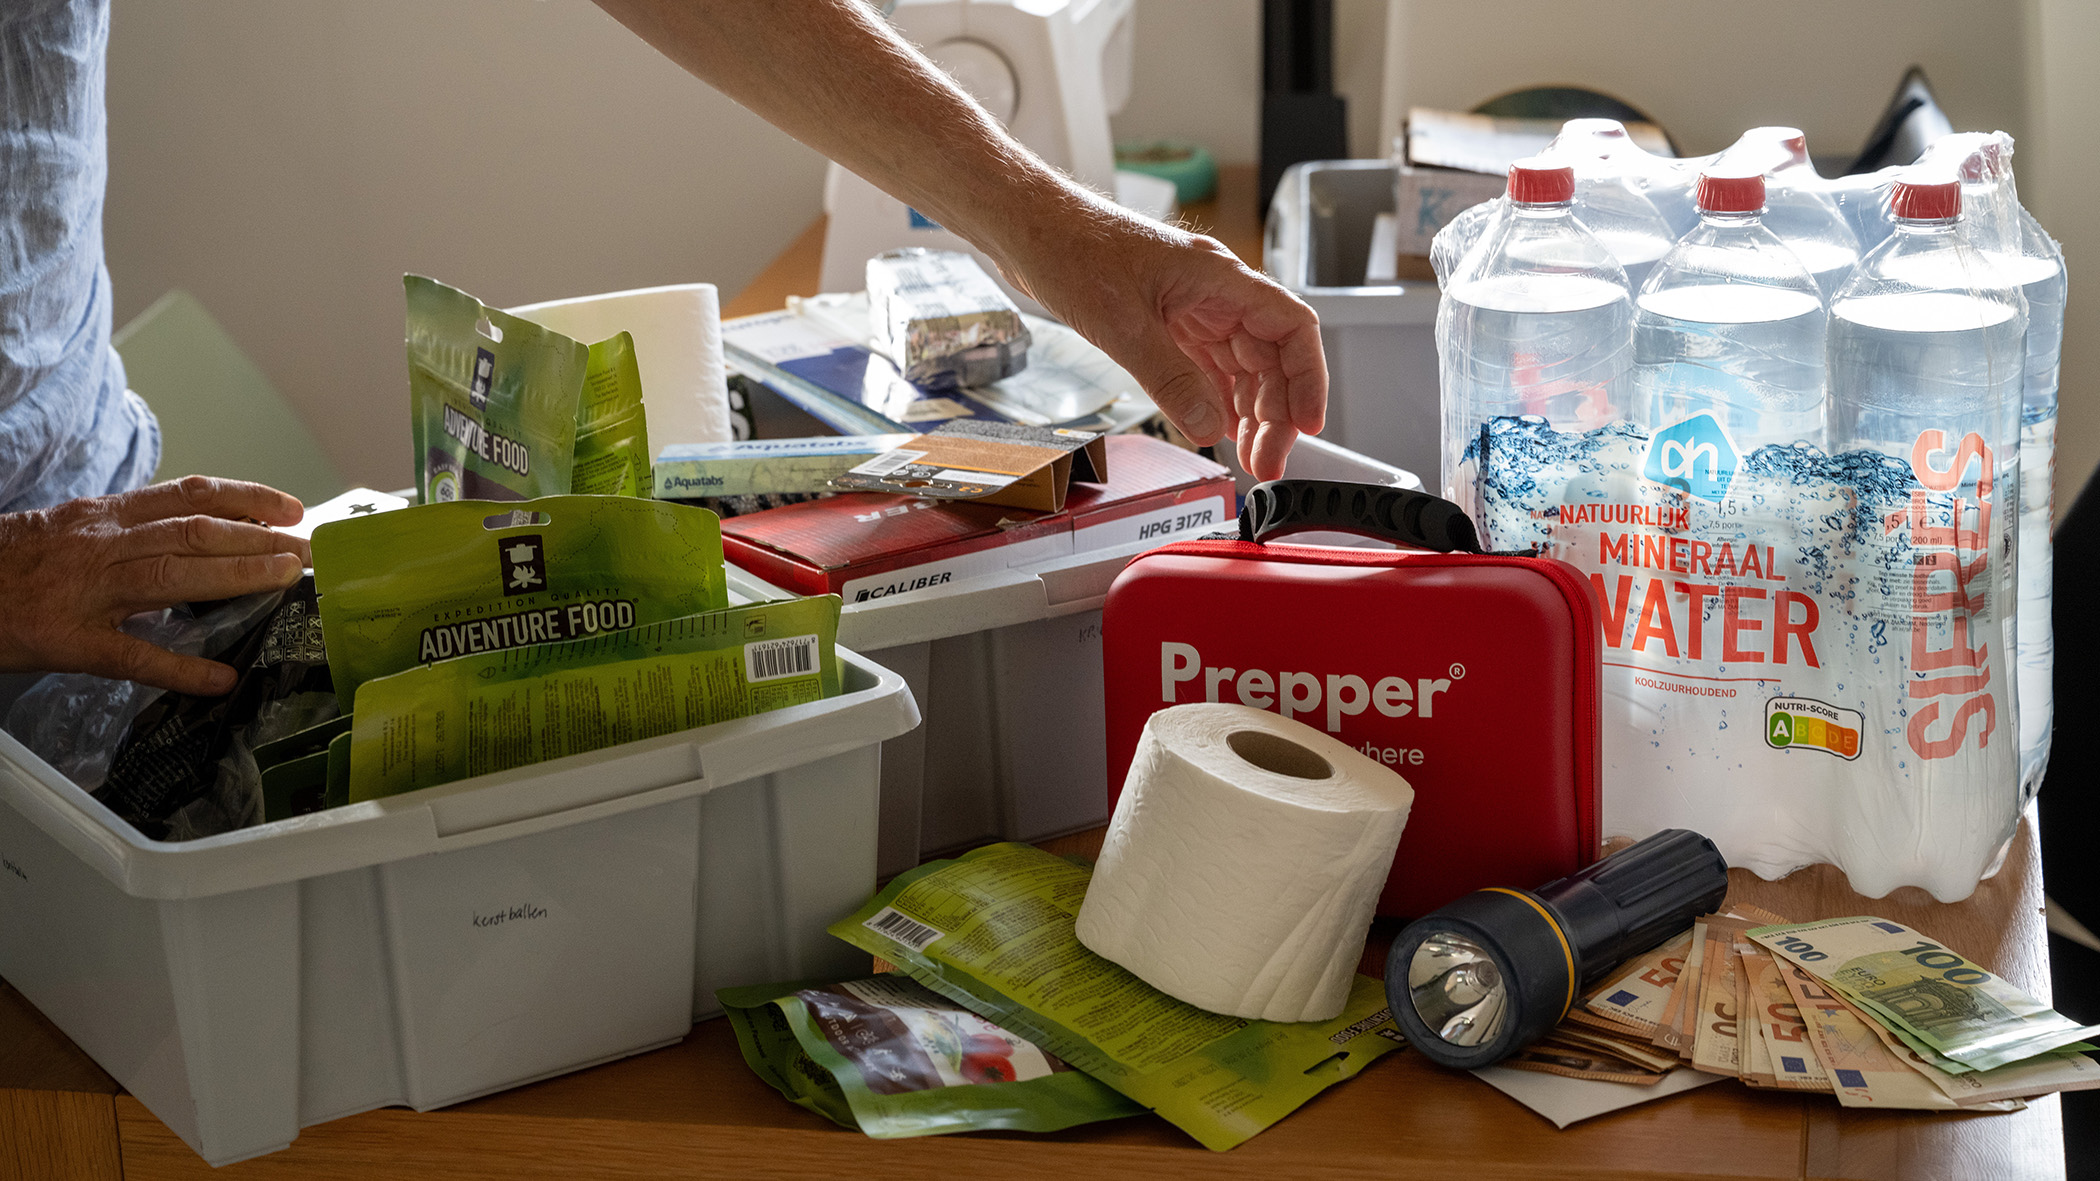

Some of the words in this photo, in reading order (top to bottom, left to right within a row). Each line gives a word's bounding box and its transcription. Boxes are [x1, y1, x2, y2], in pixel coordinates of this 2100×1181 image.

[443, 405, 490, 461] ADVENTURE
[493, 435, 530, 476] FOOD
[735, 440, 868, 451] Aquatabs
[674, 474, 725, 490] Aquatabs
[1558, 502, 1691, 531] NATUURLIJK
[1717, 500, 1737, 516] 1,5
[1139, 519, 1171, 541] HPG
[1175, 509, 1214, 532] 317R
[1911, 536, 1928, 545] (200
[1929, 536, 1943, 545] ml)
[1599, 531, 1787, 582] MINERAAL
[871, 571, 952, 601] CALIBER
[433, 597, 536, 622] EXPEDITION
[550, 587, 621, 602] QUALITY
[420, 609, 562, 661] ADVENTURE
[1589, 572, 1821, 670] WATER
[1634, 676, 1738, 698] KOOLZUURHOUDEND
[1774, 702, 1840, 721] NUTRI-SCORE
[1772, 719, 1790, 738] A
[1638, 957, 1686, 989] 50
[1775, 936, 1829, 962] 100
[1900, 941, 1991, 985] 100
[1850, 966, 1887, 987] EURO
[1767, 1002, 1808, 1043] 50
[1961, 1071, 1983, 1089] URO
